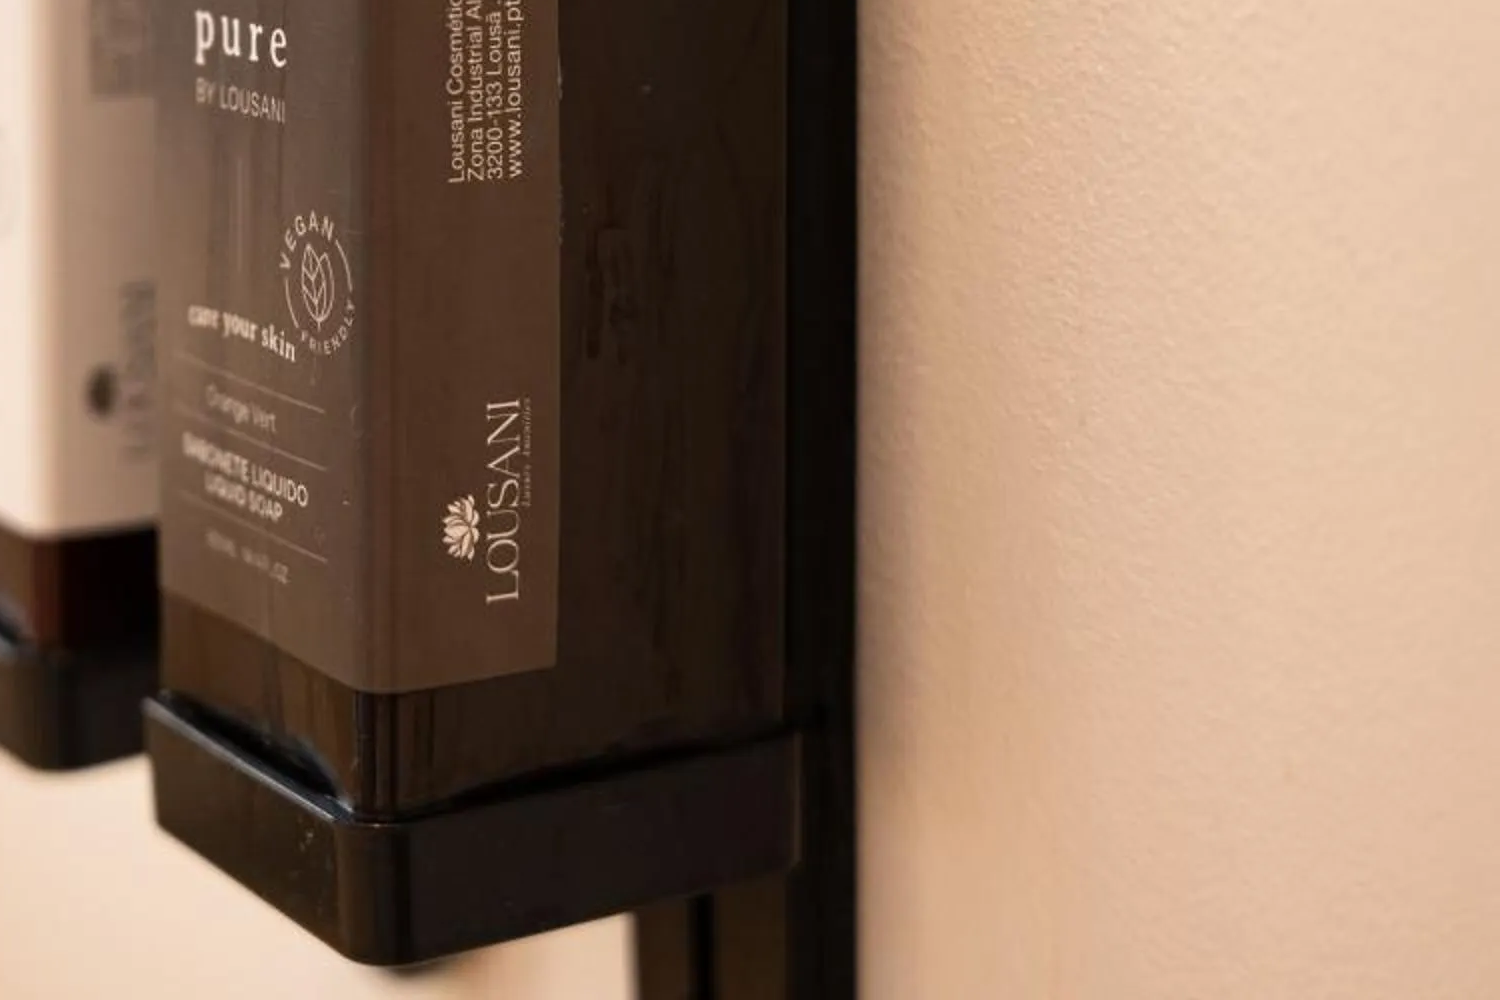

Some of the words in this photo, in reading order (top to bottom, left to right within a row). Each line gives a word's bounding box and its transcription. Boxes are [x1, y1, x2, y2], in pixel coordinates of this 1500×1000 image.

[194, 9, 288, 68] pure
[485, 11, 503, 76] Lousã
[195, 77, 215, 104] BY
[219, 85, 286, 124] LOUSANI
[467, 27, 484, 122] Industrial
[447, 100, 465, 184] Lousani
[467, 127, 485, 182] Zona
[485, 82, 503, 180] 3200-133
[279, 209, 335, 269] VEGAN
[222, 311, 258, 343] your
[261, 323, 297, 363] skin
[300, 299, 356, 355] FRIENDLY
[486, 400, 521, 605] LOUSANI
